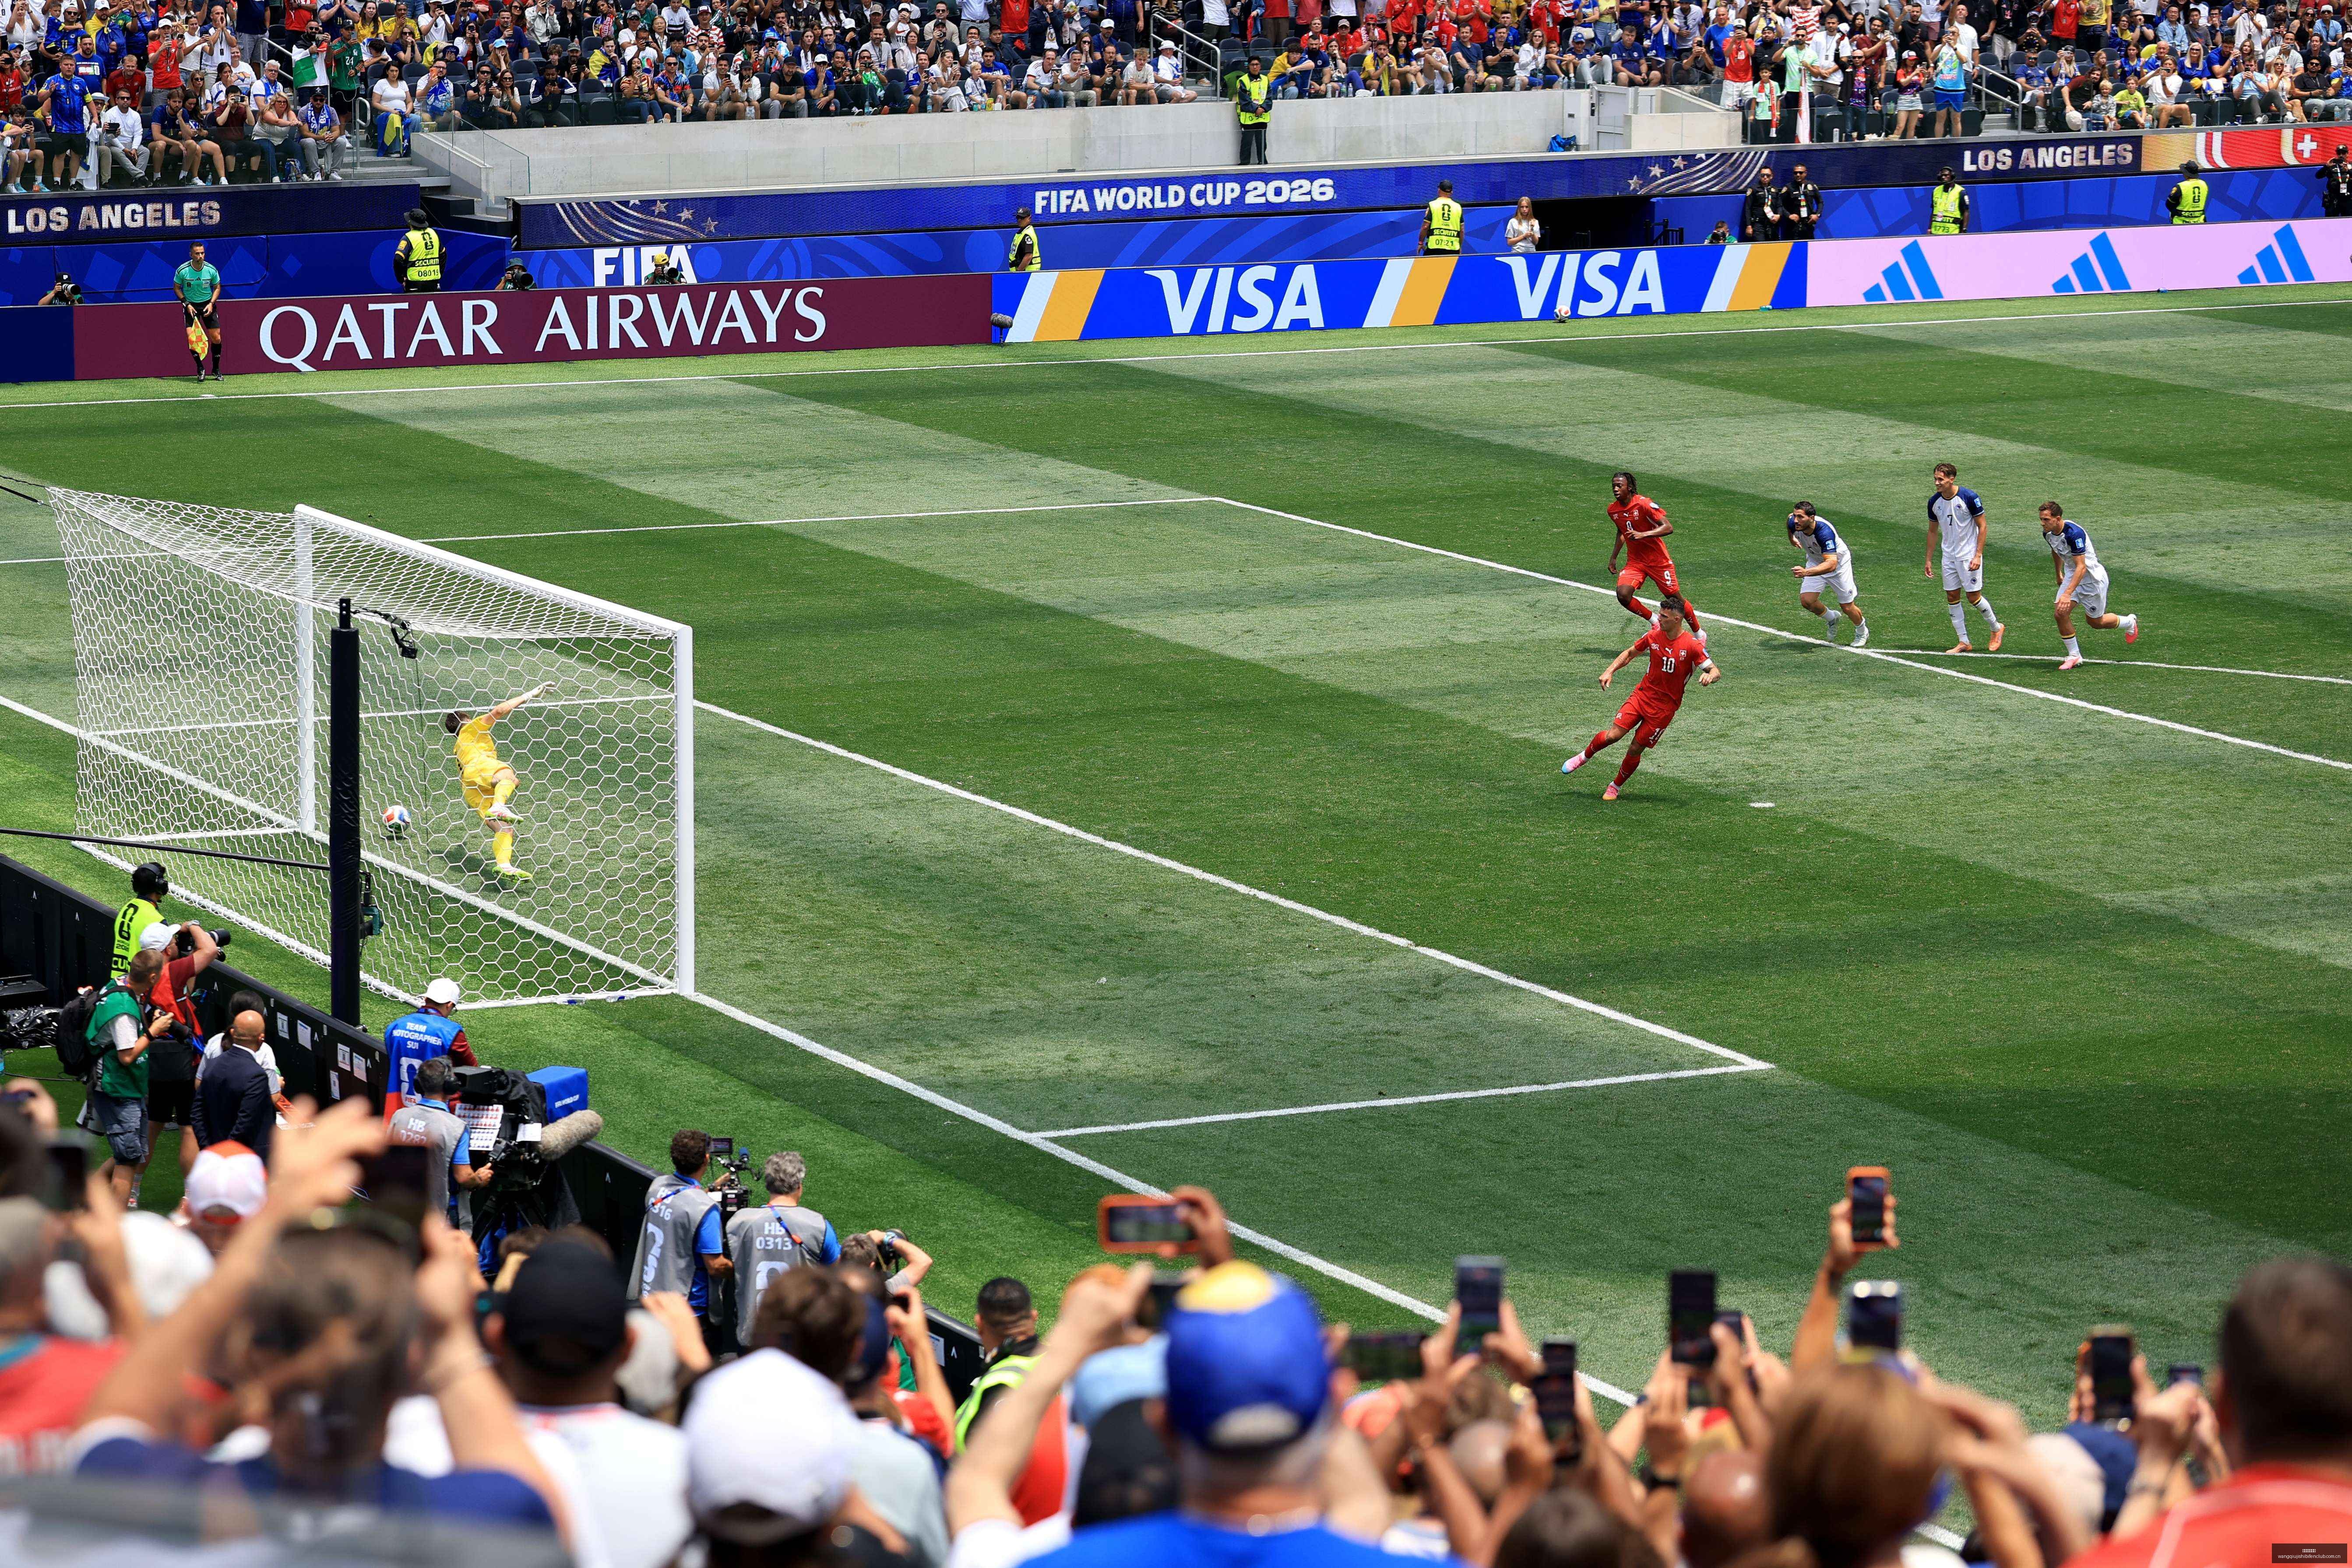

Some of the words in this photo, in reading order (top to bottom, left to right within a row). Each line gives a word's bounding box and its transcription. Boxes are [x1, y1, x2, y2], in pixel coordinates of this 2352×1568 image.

[1964, 149, 2012, 171] LOS
[2019, 144, 2133, 168] ANGELES
[1035, 189, 1089, 214] FIFA
[1094, 185, 1185, 211] WORLD
[1190, 181, 1241, 207] CUP
[1245, 178, 1334, 204] 2026
[7, 206, 68, 233] LOS
[78, 201, 220, 229] ANGELES
[1495, 250, 1665, 319] VISA
[1144, 264, 1324, 334] VISA
[259, 300, 503, 371] QATAR
[535, 286, 826, 352] AIRWAYS
[1947, 514, 1953, 525] 7
[1664, 571, 1671, 585] 9
[1662, 656, 1675, 673] 10
[406, 1022, 427, 1032] TEAM
[406, 1041, 419, 1049] SUI
[408, 1117, 426, 1132] HB
[756, 1237, 792, 1250] 0313
